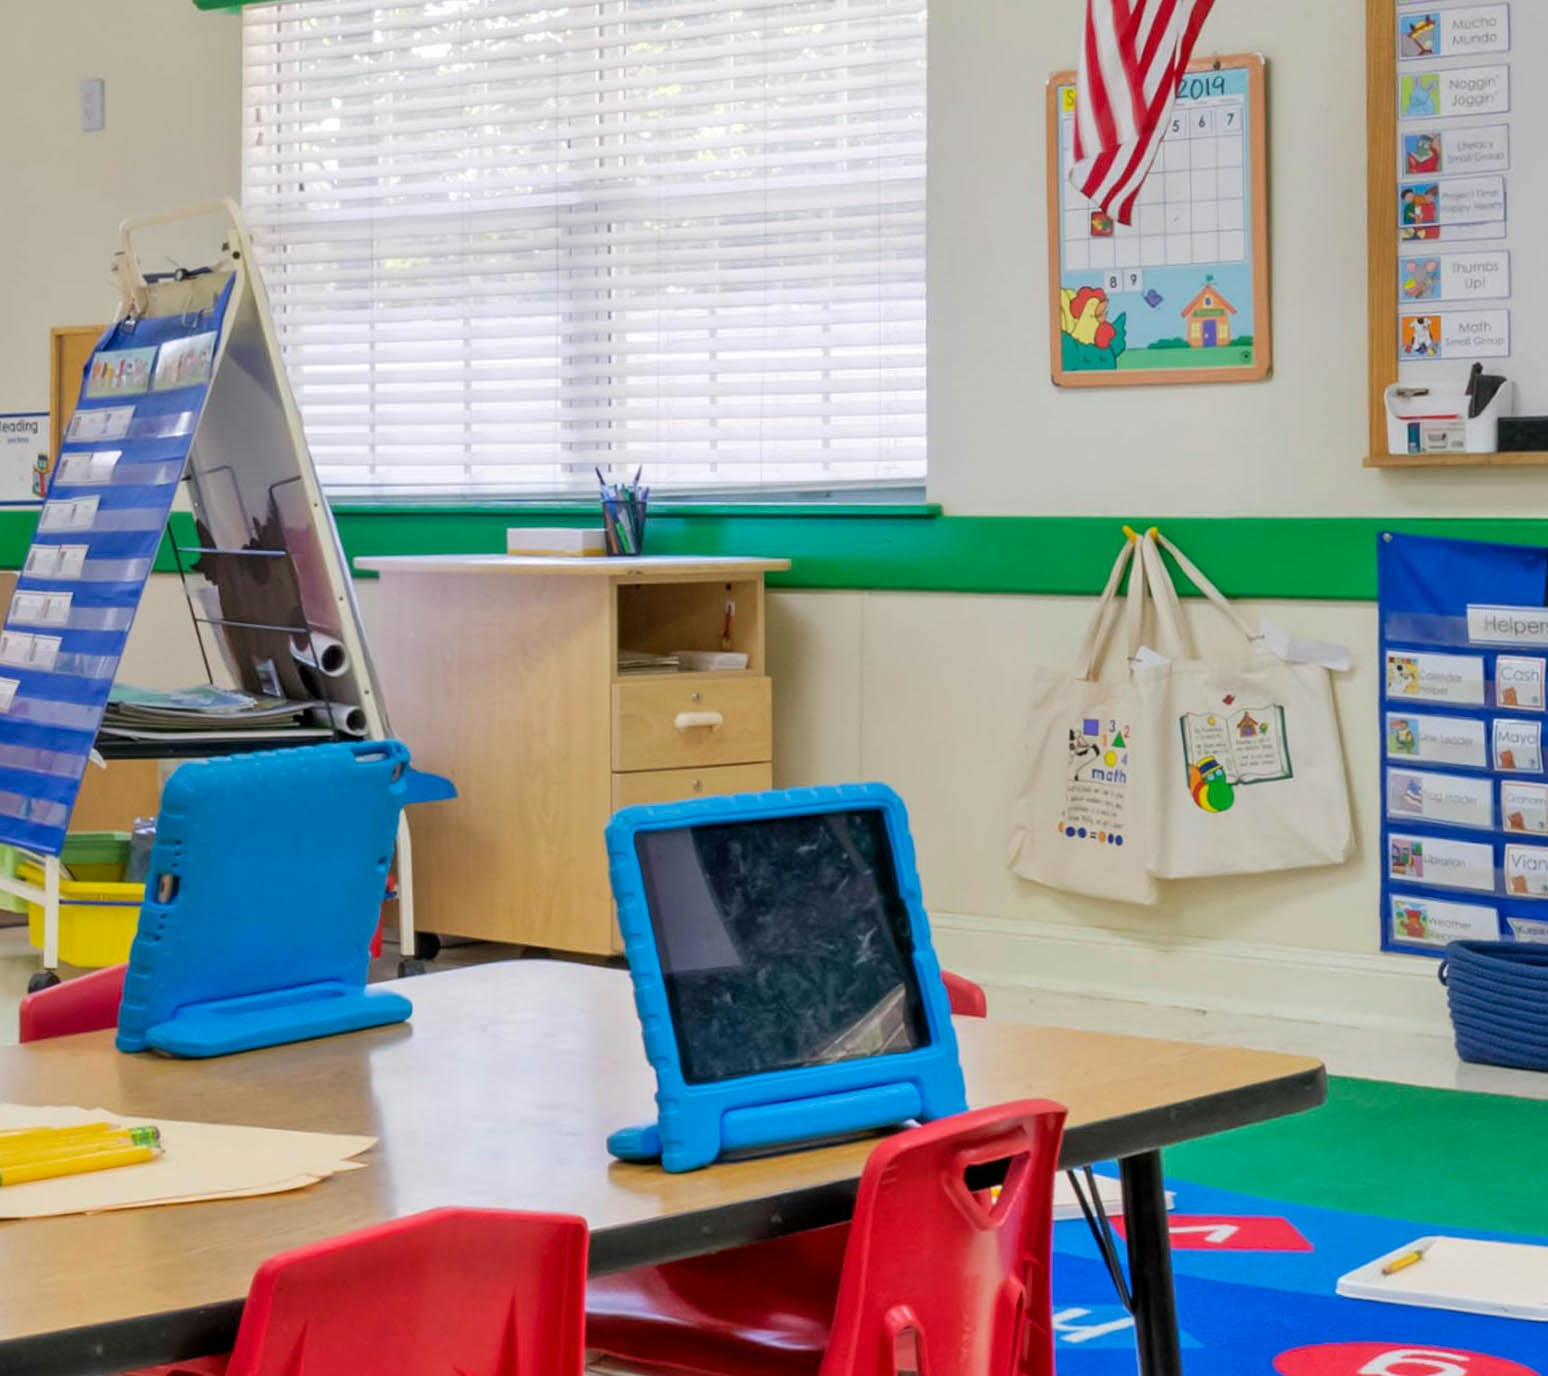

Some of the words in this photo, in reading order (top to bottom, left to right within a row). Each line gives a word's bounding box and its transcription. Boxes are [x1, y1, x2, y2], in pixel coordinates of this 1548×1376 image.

[1451, 17, 1497, 30] Mucho
[1452, 32, 1498, 46] Mundo
[1176, 77, 1225, 100] 2019
[1172, 120, 1180, 132] 5
[1198, 115, 1206, 128] 6
[1226, 113, 1234, 126] 7
[1451, 261, 1499, 274] Thumbs
[1110, 276, 1118, 288] 8
[1130, 274, 1137, 286] 9
[1464, 277, 1486, 291] Up!
[1458, 321, 1492, 334] Math
[1499, 665, 1539, 681] Cash
[1109, 720, 1116, 732] 3
[1124, 725, 1130, 738] 2
[1499, 730, 1538, 745] Maya
[1092, 768, 1127, 784] math
[1511, 853, 1548, 871] Vian
